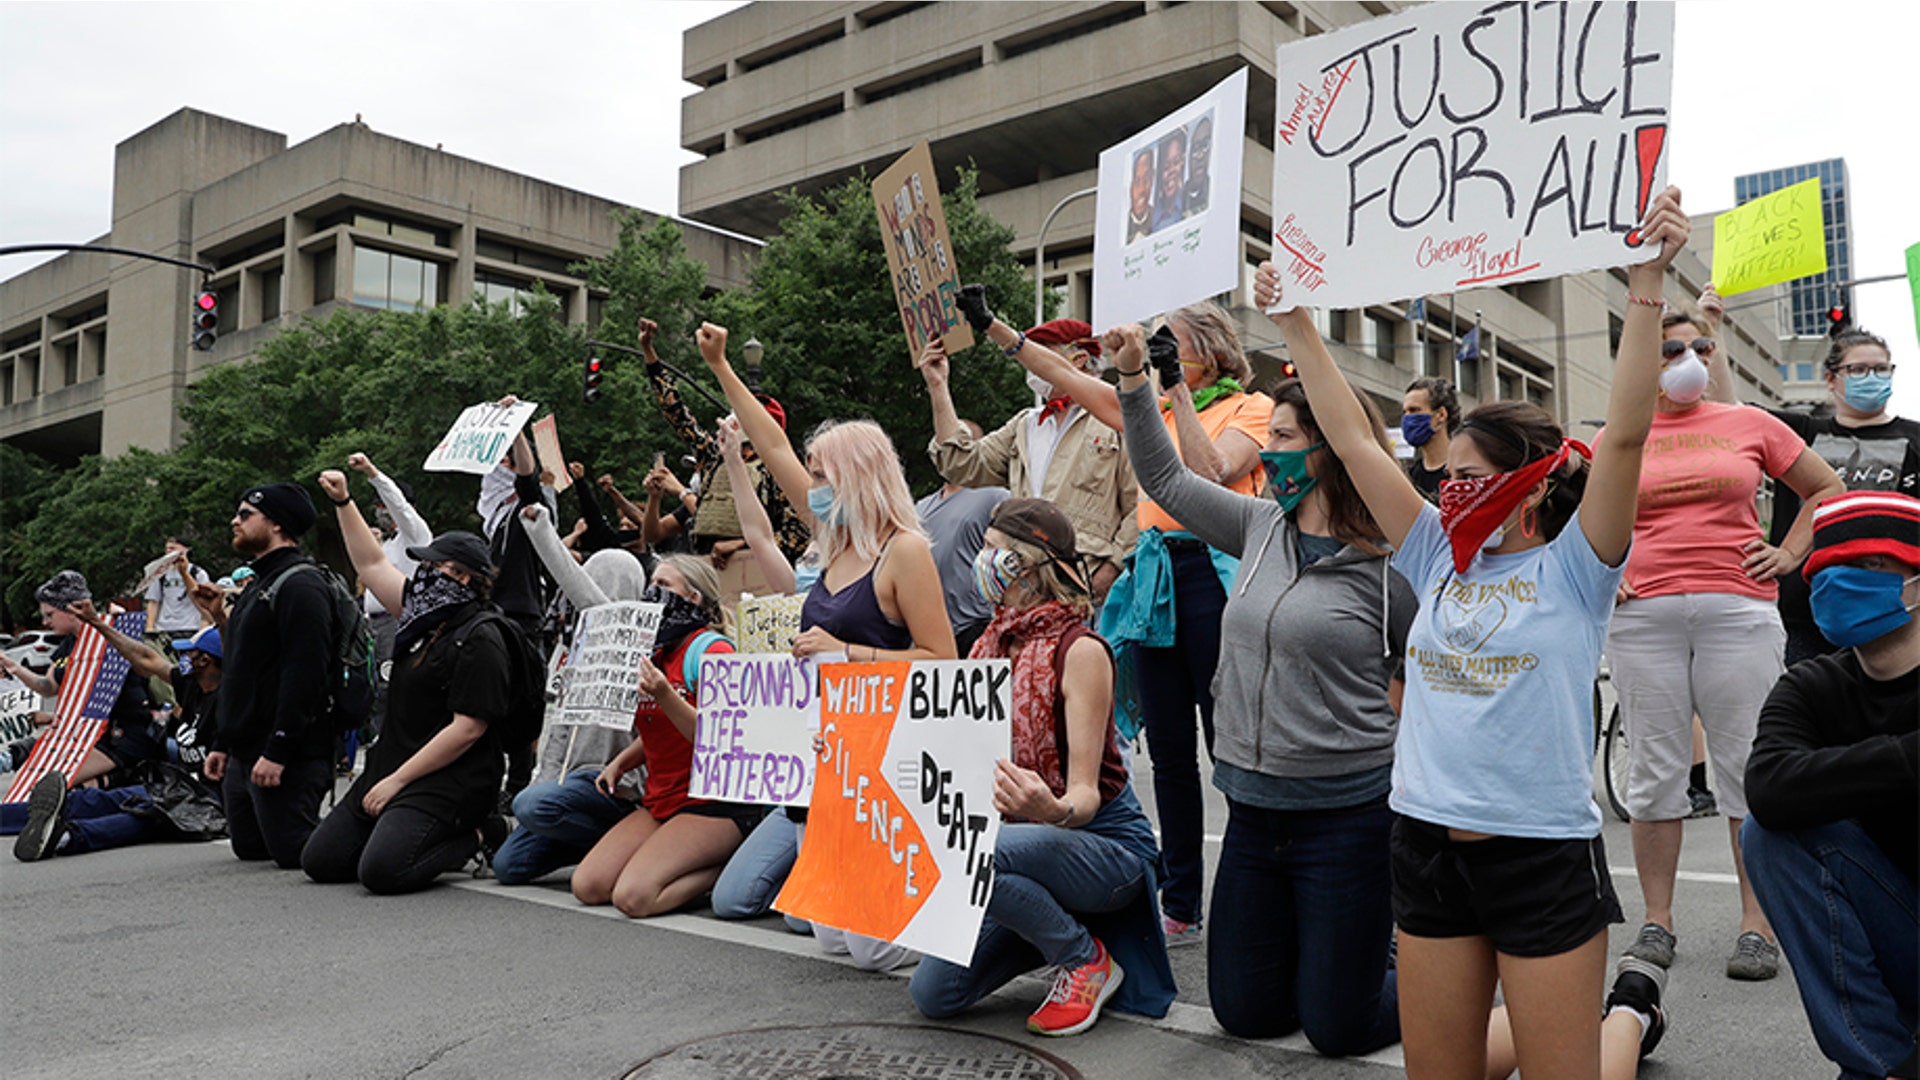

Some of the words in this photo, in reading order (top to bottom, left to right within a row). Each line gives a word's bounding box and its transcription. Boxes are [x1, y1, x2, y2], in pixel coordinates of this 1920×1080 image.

[1308, 0, 1667, 157] JUSTICE
[1346, 126, 1516, 247] FOR
[1724, 186, 1805, 243] BLACK
[1732, 217, 1802, 261] LIVES
[1416, 231, 1488, 268] George
[1723, 242, 1805, 287] MATTER!
[746, 606, 801, 636] Justice
[700, 656, 811, 710] BREONNA'S
[824, 673, 895, 715] WHITE
[909, 664, 1011, 722] BLACK
[695, 709, 748, 754] LIFE
[693, 752, 805, 802] MATTERED
[819, 721, 921, 898] SILENCE
[921, 750, 995, 908] DEATH
